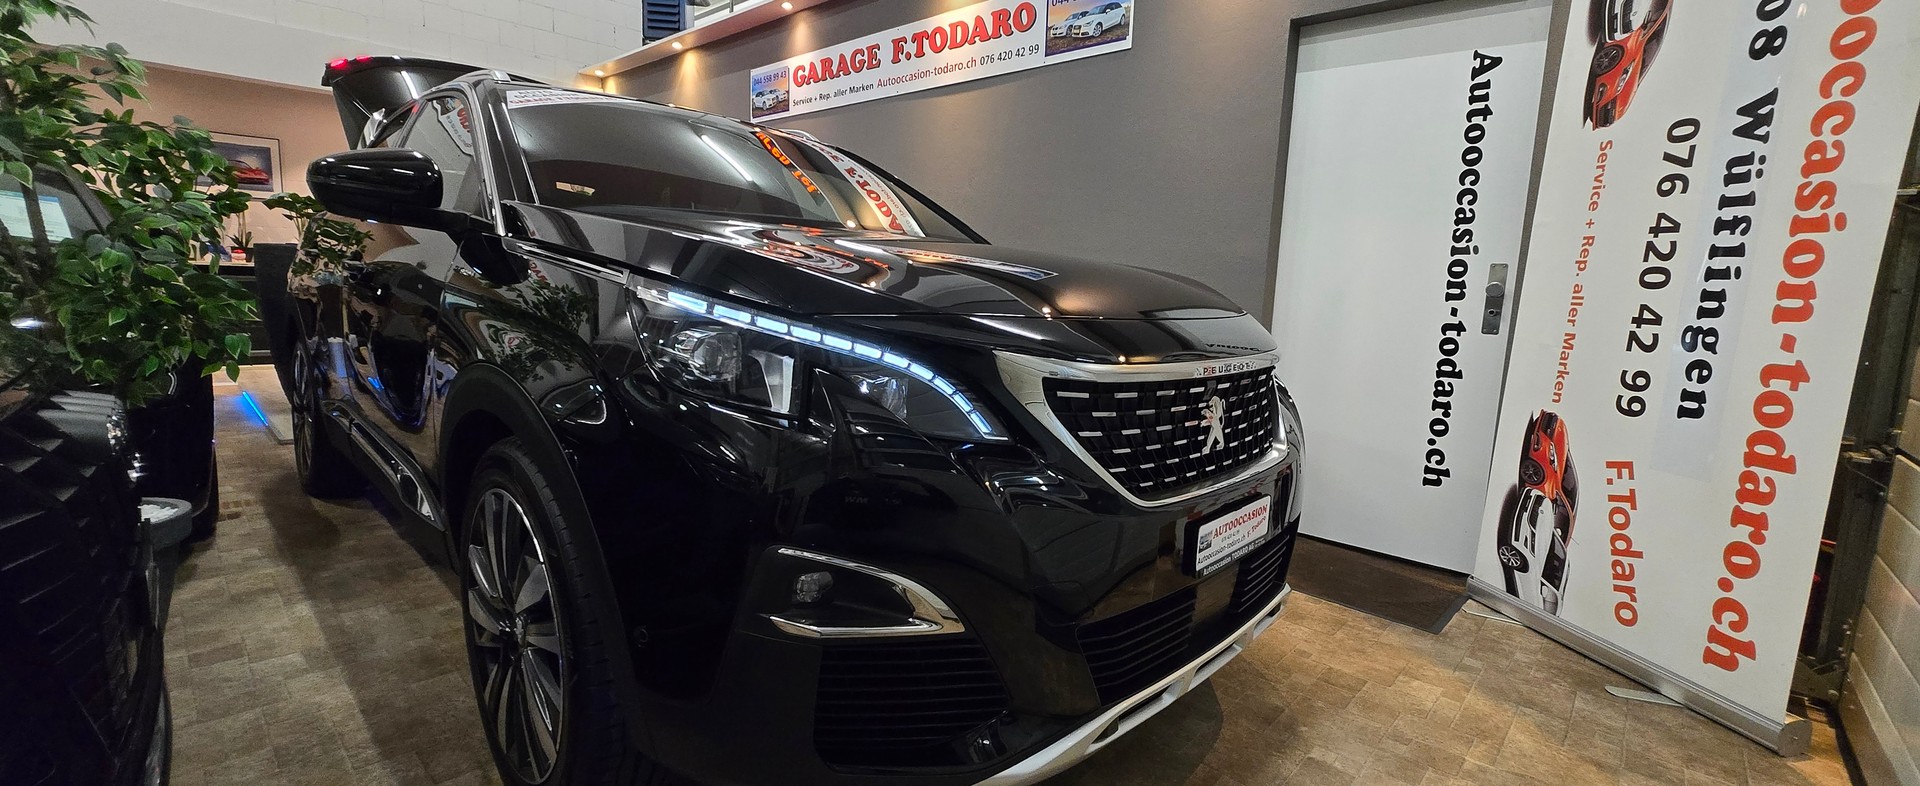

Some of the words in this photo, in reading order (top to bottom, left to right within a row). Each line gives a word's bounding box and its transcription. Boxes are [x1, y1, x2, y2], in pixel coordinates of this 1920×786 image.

[792, 43, 881, 87] GARAGE
[891, 2, 1037, 64] F.TODARO
[793, 97, 813, 107] Service
[819, 91, 832, 101] Rep.
[833, 87, 848, 97] aller
[849, 83, 874, 94] Marken
[877, 57, 977, 88] Autooccasion-todaro.ch
[979, 53, 995, 66] 076
[997, 50, 1013, 63] 420
[1015, 47, 1026, 59] 42
[1028, 44, 1040, 55] 99
[1587, 139, 1613, 212] Service
[1656, 117, 1701, 198] 076
[1422, 49, 1503, 488] Autooccasion-todaro.ch
[1575, 236, 1595, 277] Rep.
[1638, 212, 1682, 290] 420
[1676, 87, 1779, 420] Wülflingen
[1567, 283, 1585, 327] aller
[1625, 303, 1664, 353] 42
[1203, 361, 1252, 374] PEUGEOT
[1552, 332, 1577, 404] Marken
[1615, 369, 1651, 418] 99
[1213, 504, 1268, 539] AUTOOCCASION
[1605, 460, 1643, 627] F.Todaro
[1203, 556, 1231, 576] Autooccasion
